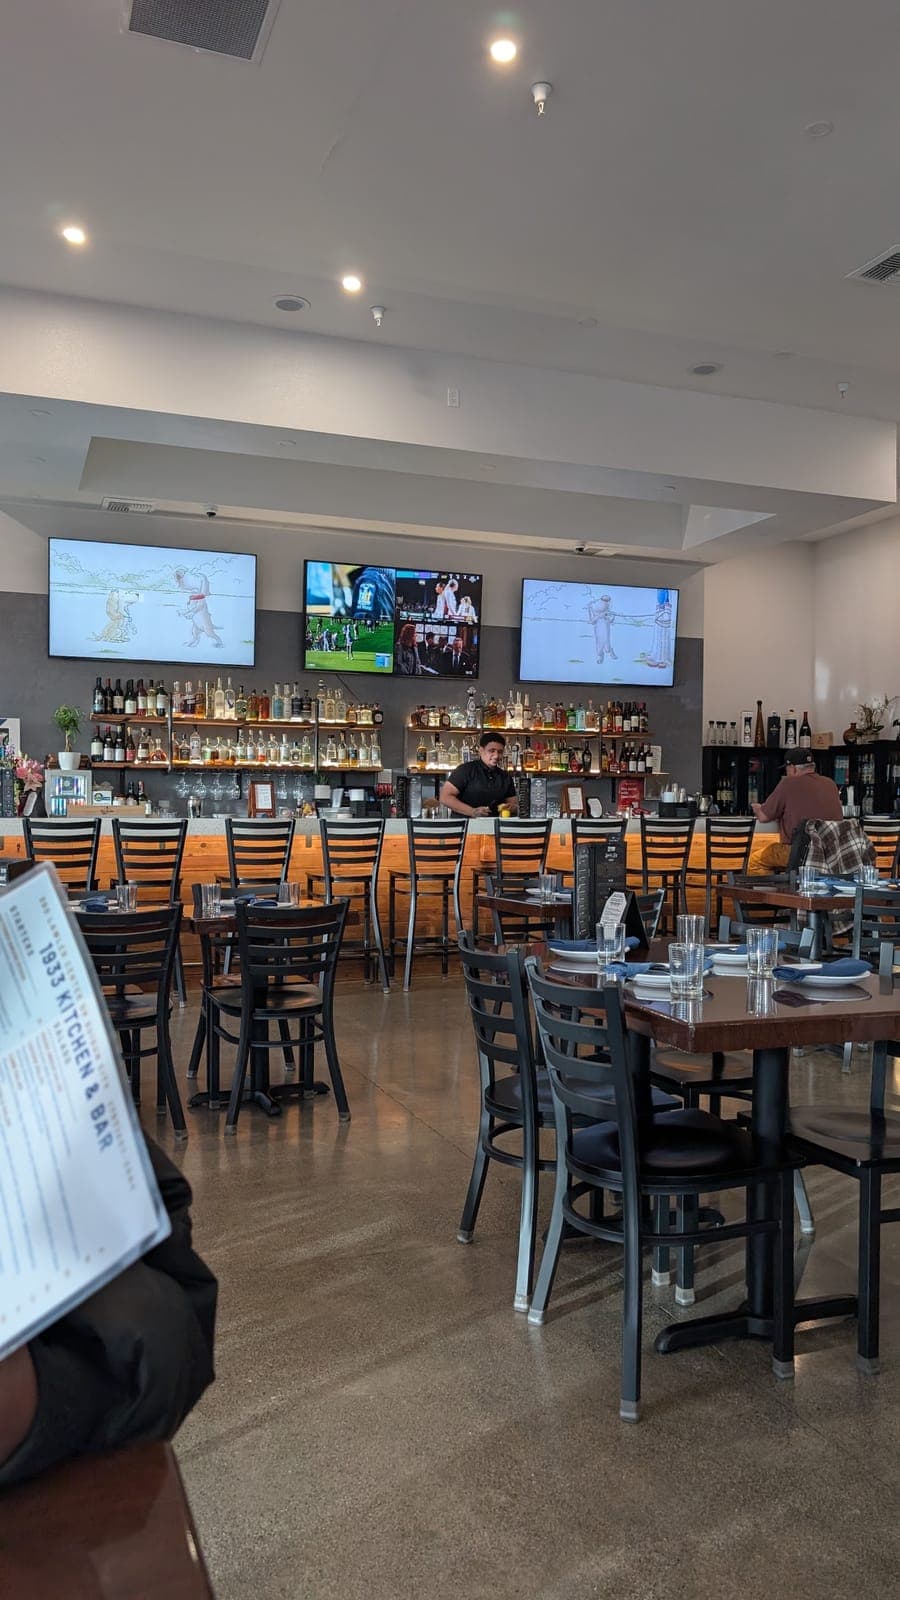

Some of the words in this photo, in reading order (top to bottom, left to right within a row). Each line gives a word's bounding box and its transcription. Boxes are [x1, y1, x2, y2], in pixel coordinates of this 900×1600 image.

[9, 905, 33, 956] STARTERS
[39, 942, 65, 987] 1933
[55, 989, 93, 1079] KITCHEN
[84, 1082, 99, 1101] &
[89, 1102, 112, 1152] BAR
